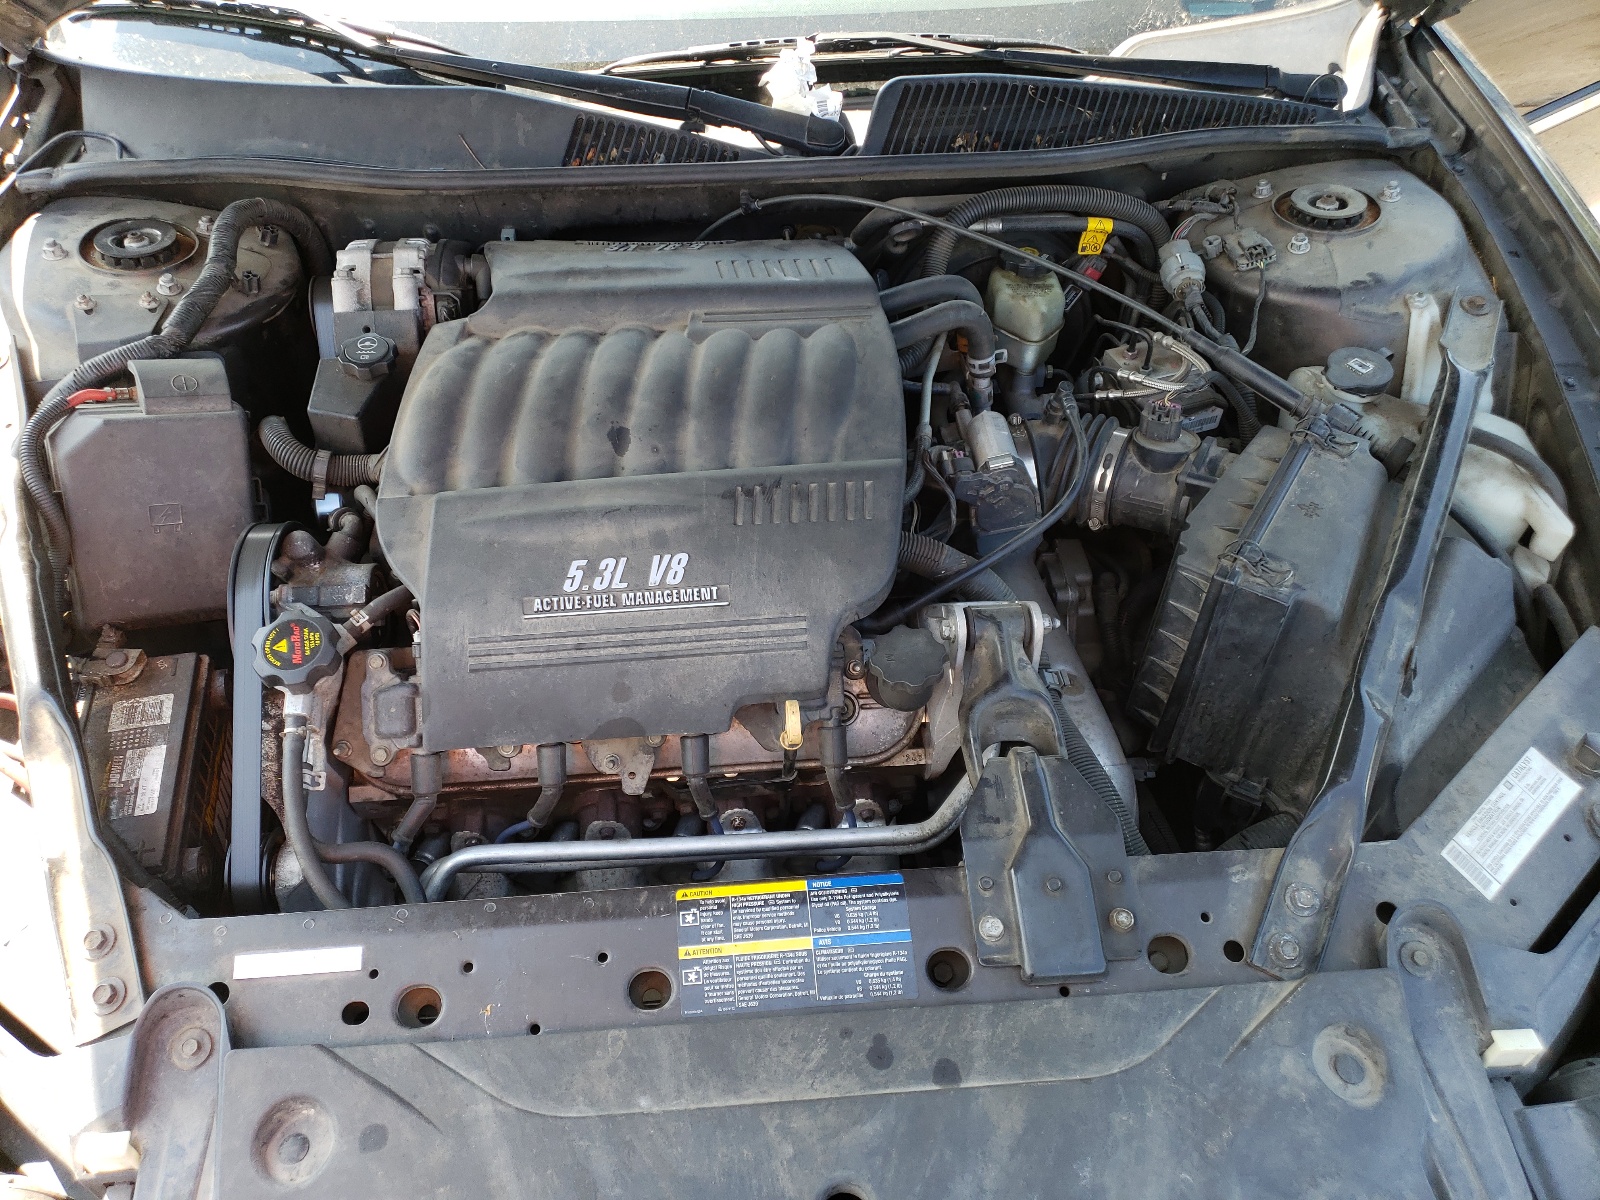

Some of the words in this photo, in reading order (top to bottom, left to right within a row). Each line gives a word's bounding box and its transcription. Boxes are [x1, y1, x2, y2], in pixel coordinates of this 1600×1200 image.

[563, 557, 629, 593] 5.3L
[649, 553, 689, 587] V8
[622, 586, 719, 606] MANAGEMENT
[1510, 755, 1532, 779] CATALYST
[692, 946, 722, 955] ATTENTION
